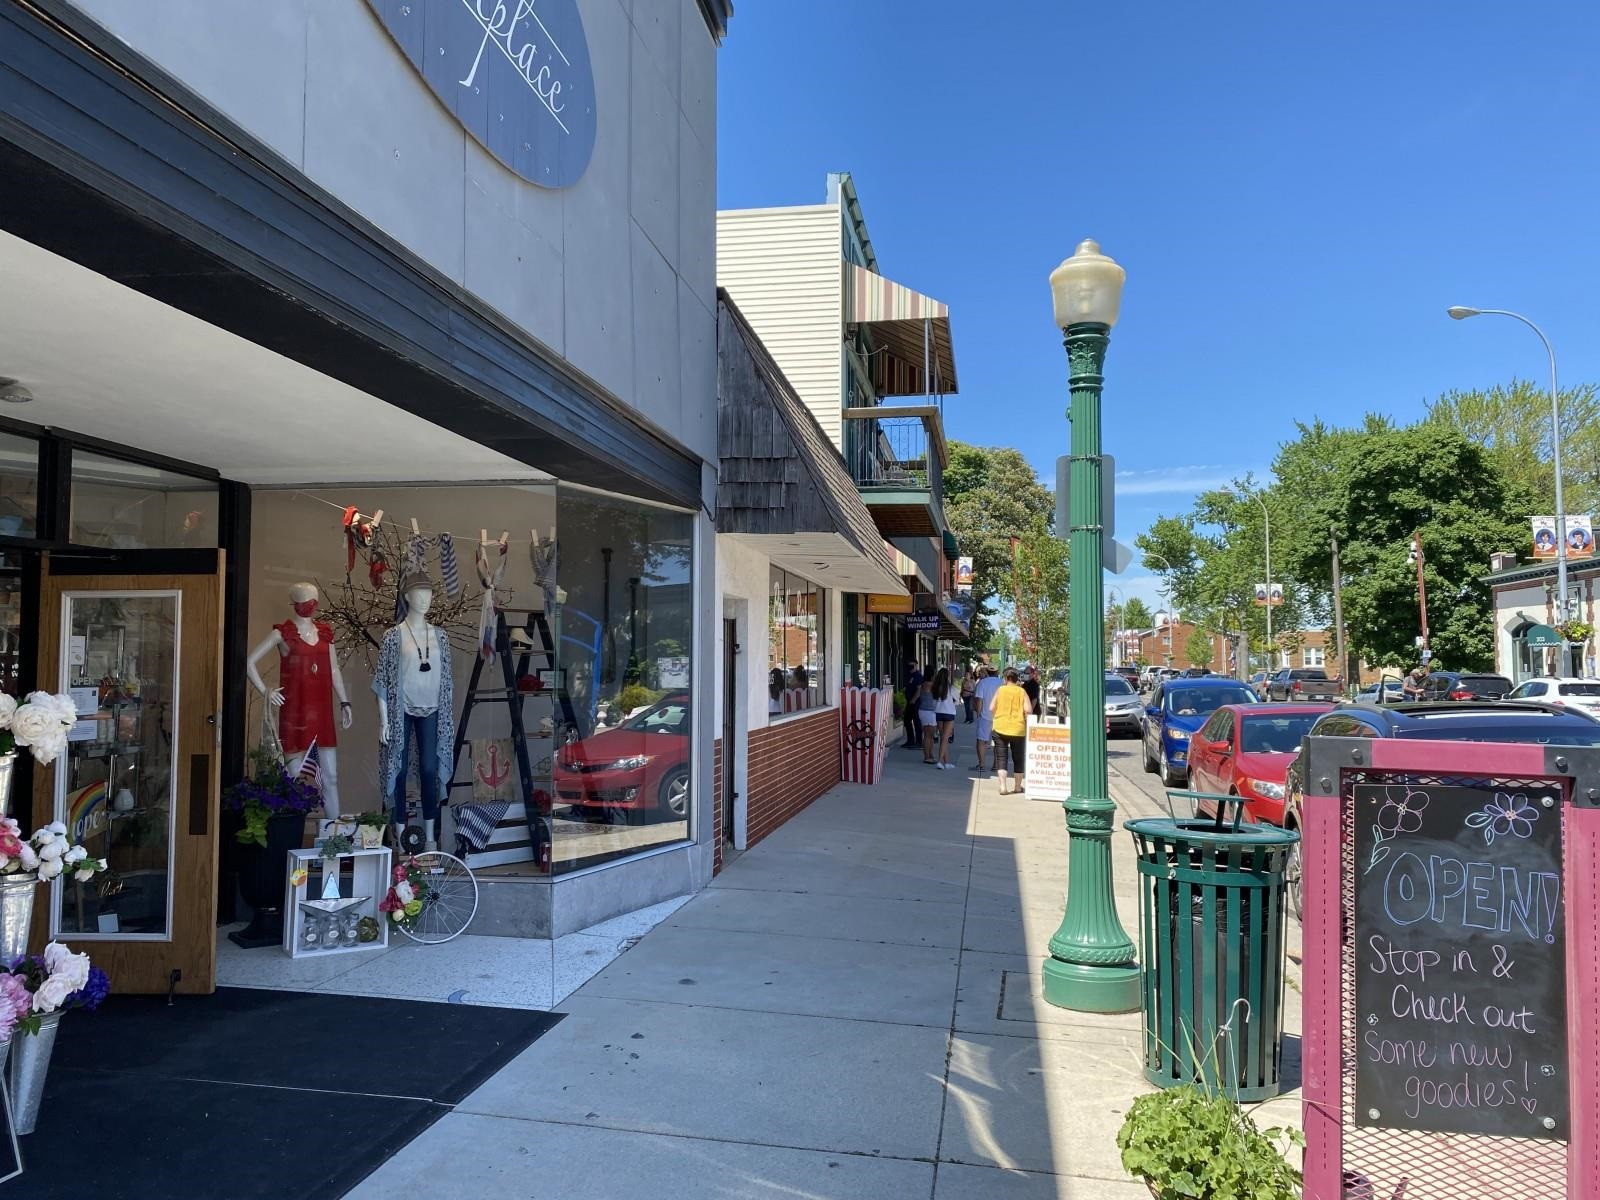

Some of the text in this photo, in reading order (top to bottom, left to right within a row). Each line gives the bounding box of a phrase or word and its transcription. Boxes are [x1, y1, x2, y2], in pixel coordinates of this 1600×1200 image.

[1028, 753, 1052, 761] CURB
[1036, 744, 1066, 753] OPEN
[1383, 852, 1560, 945] OPEN!
[1369, 934, 1516, 982] Stop in &
[1391, 984, 1536, 1034] Check out
[1450, 1042, 1513, 1069] new
